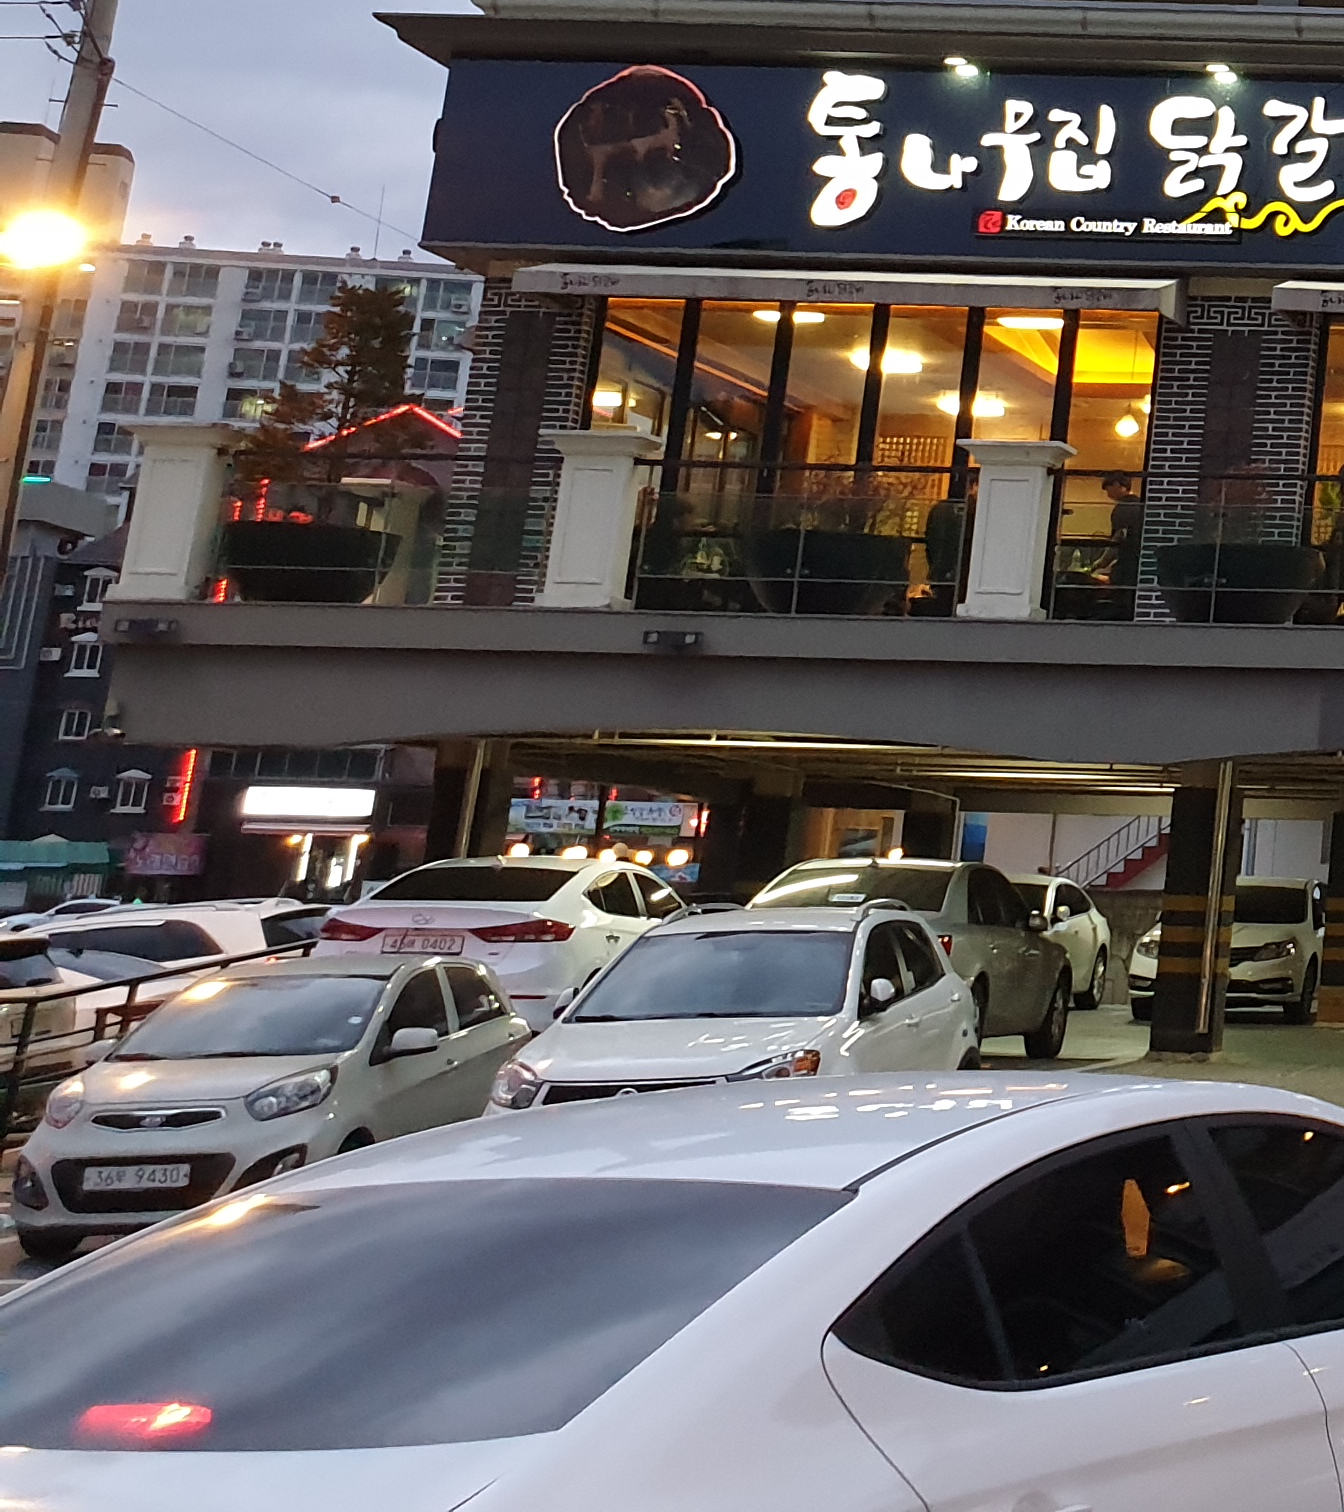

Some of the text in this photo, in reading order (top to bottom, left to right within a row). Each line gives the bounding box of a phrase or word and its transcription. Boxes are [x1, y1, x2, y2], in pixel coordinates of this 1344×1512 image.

[808, 70, 1117, 229] 통나무집
[1005, 213, 1235, 236] Korean Country Restaurant
